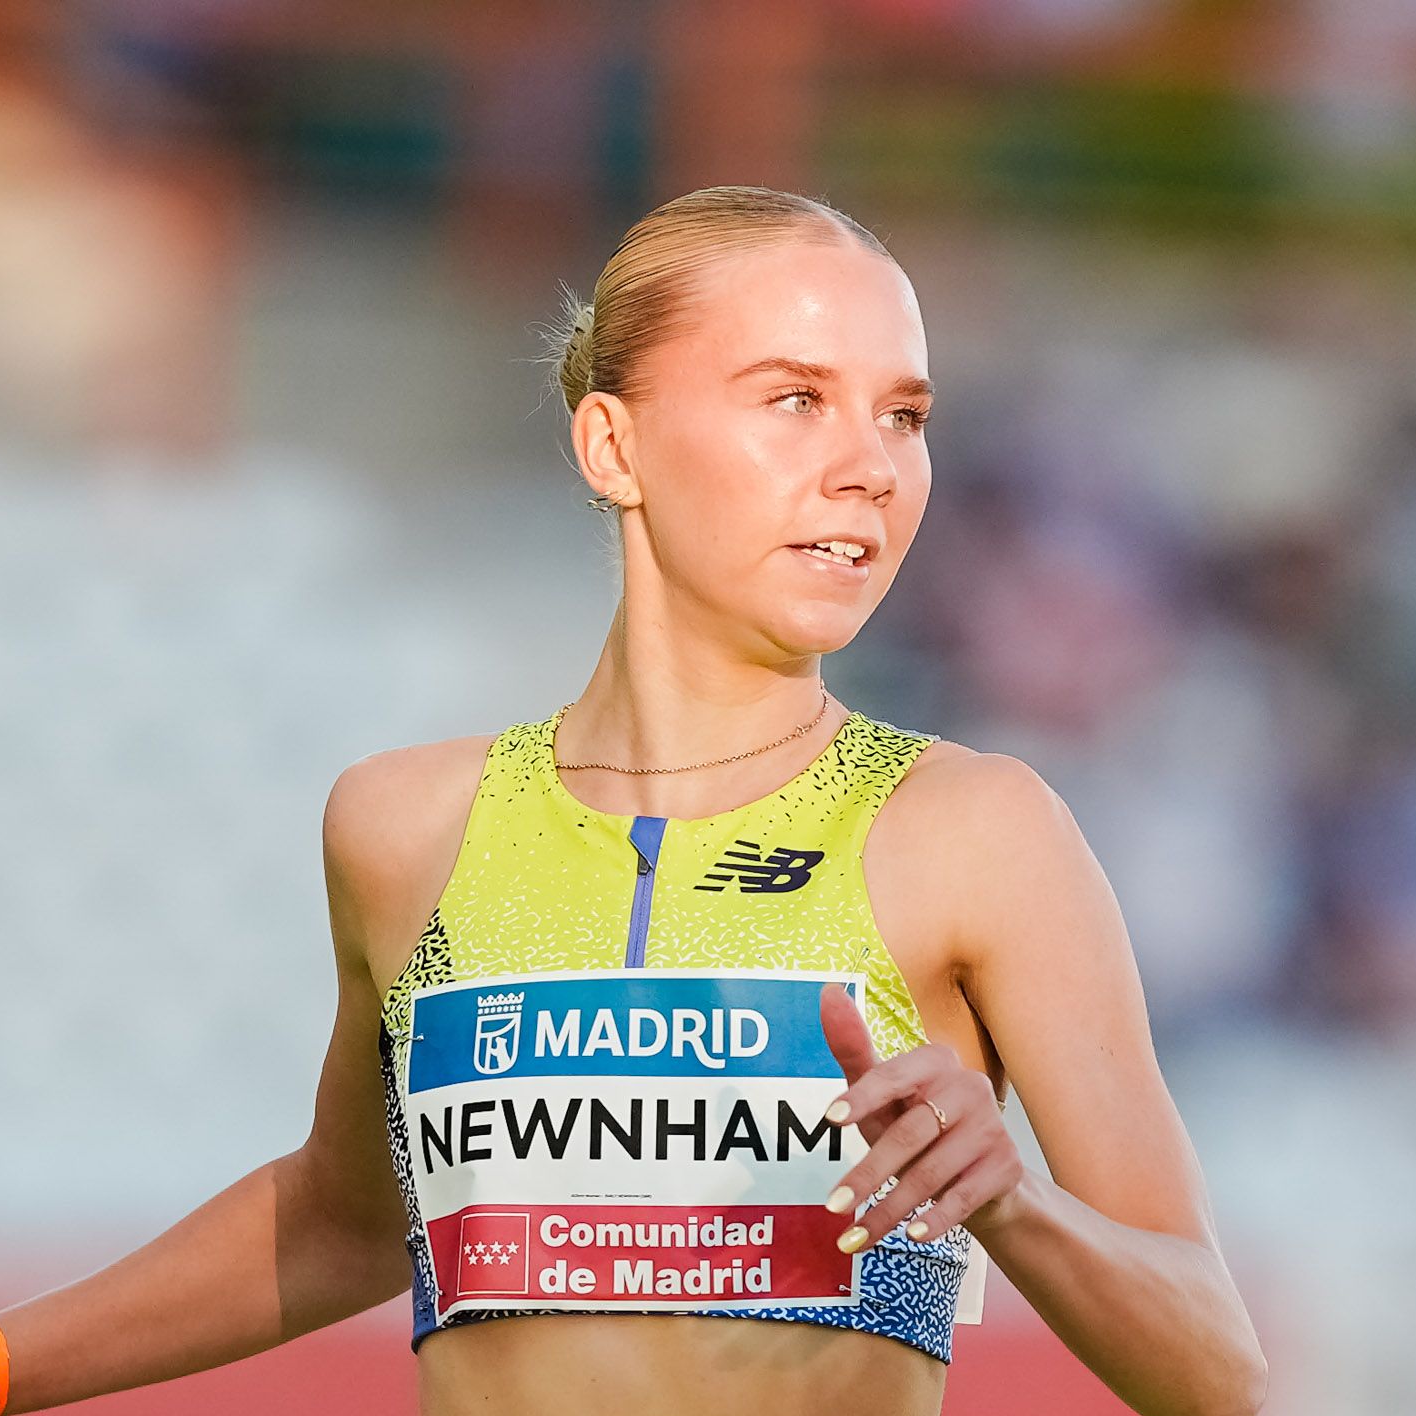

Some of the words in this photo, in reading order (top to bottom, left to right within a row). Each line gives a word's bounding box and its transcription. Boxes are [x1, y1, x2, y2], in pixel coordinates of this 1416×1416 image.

[535, 1008, 770, 1070] MADRID
[419, 1097, 844, 1175] NEWNHAM
[539, 1214, 774, 1249] Comunidad
[539, 1259, 597, 1295] de
[612, 1256, 773, 1296] Madrid
